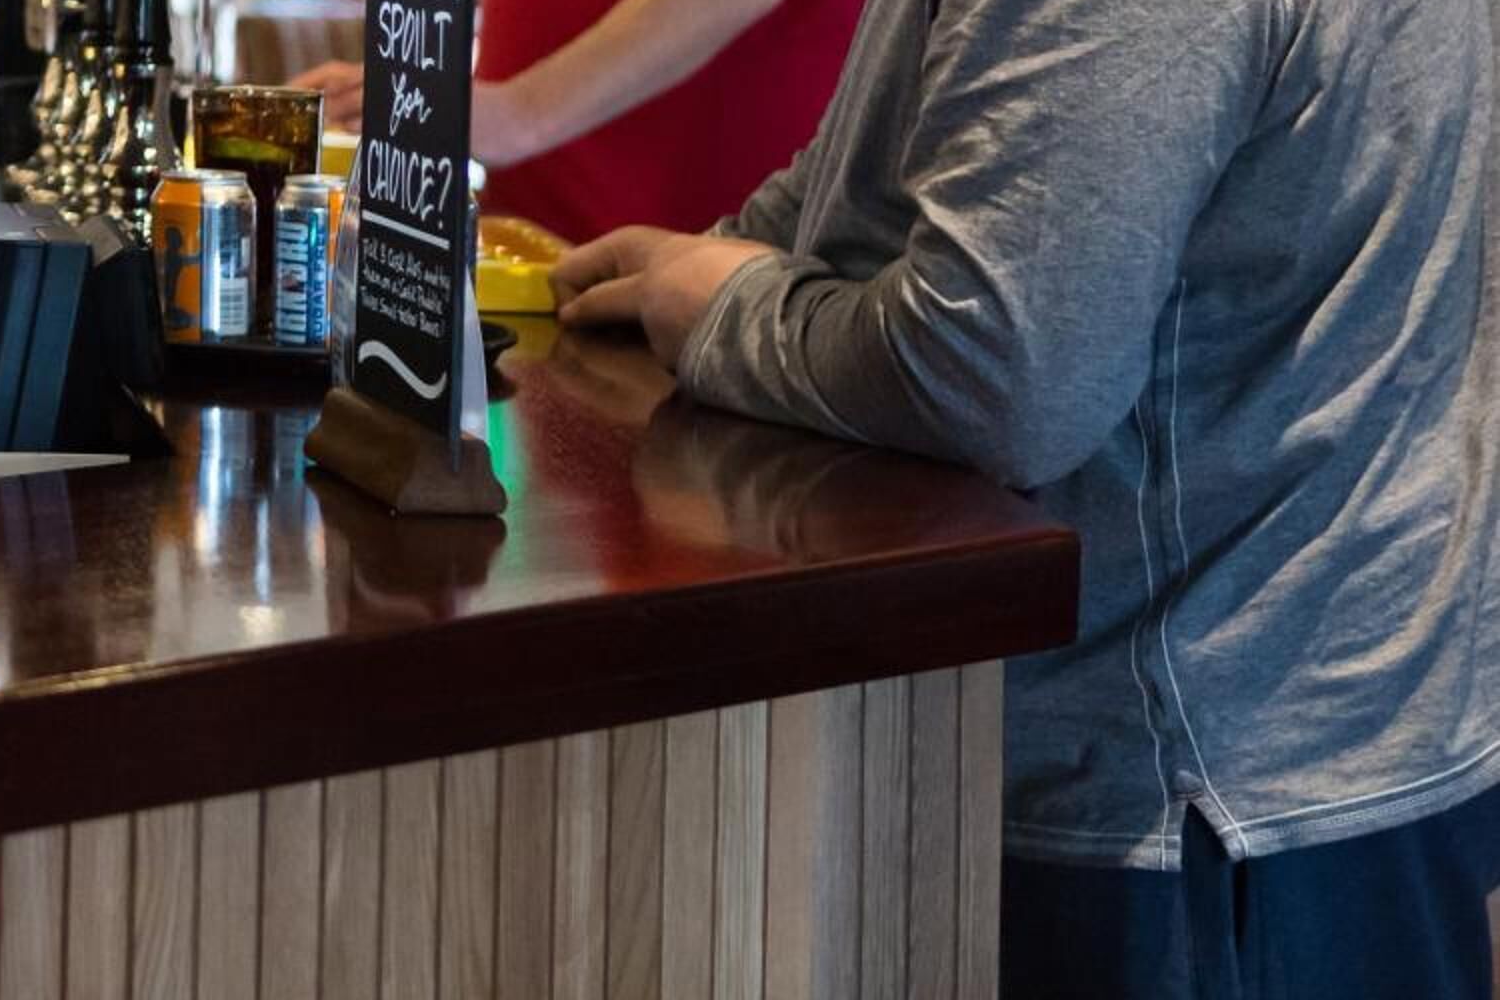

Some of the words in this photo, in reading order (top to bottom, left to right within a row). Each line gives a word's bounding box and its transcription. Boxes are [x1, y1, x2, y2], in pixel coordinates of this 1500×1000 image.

[377, 1, 453, 71] SPOILT
[389, 72, 432, 137] for
[366, 139, 453, 229] CHOICE?
